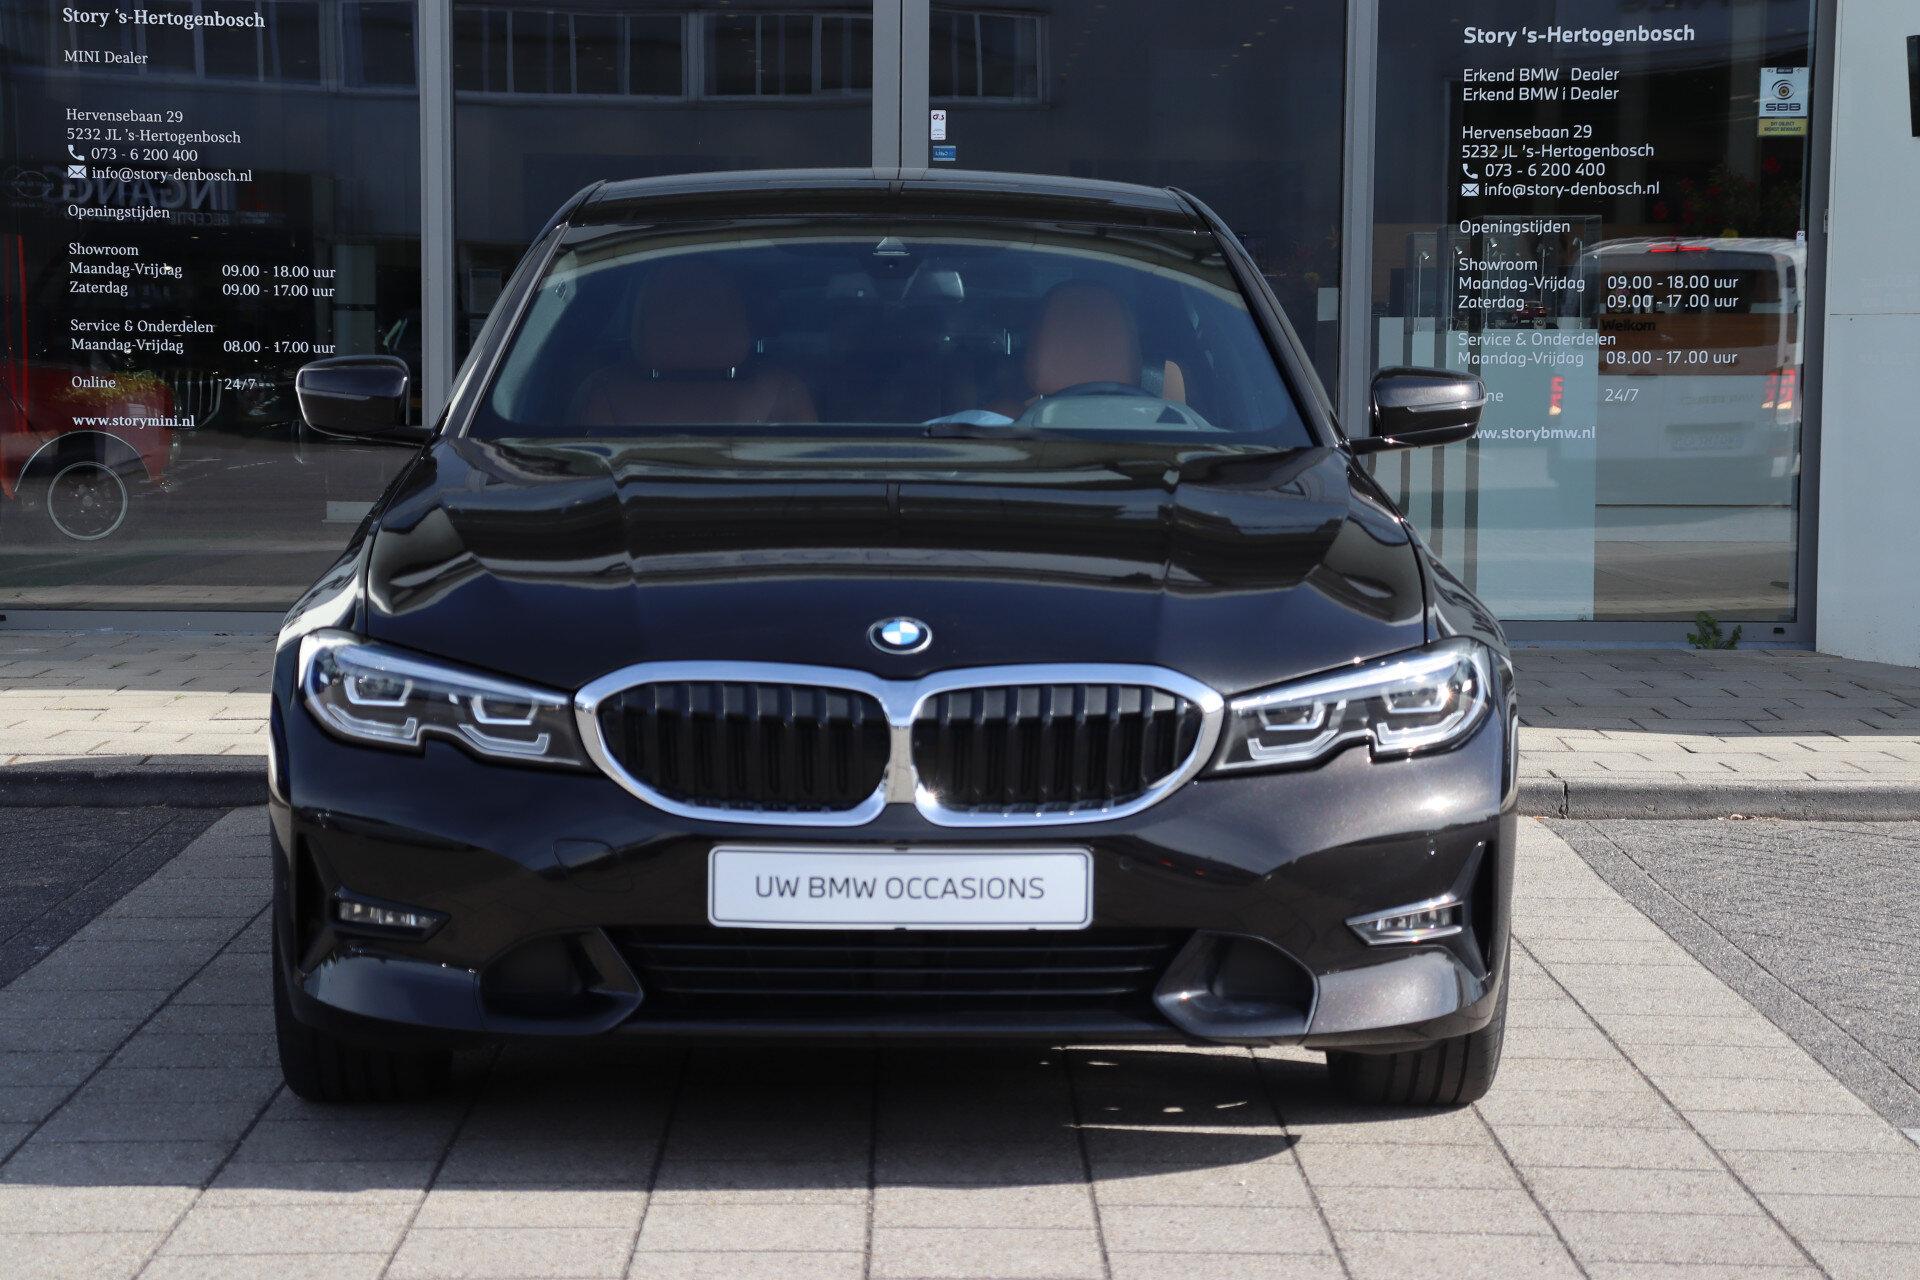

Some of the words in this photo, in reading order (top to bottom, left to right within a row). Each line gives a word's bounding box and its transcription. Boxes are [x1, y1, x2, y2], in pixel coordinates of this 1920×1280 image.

[62, 7, 109, 27] Story
[1463, 27, 1517, 47] Story
[64, 50, 100, 63] MINI
[104, 51, 149, 65] Dealer
[1463, 68, 1515, 82] Erkend
[1519, 68, 1559, 82] BMW
[1571, 67, 1620, 81] Dealer
[1463, 88, 1515, 101] Erkend
[1518, 87, 1559, 101] BMW
[1562, 86, 1566, 101] i
[1570, 86, 1620, 101] Dealer
[66, 108, 162, 123] Hervensebaan
[166, 111, 184, 123] 29
[66, 127, 101, 141] 5232
[104, 128, 122, 141] JL
[1462, 126, 1569, 140] Hervensebaan
[1573, 124, 1593, 139] 29
[91, 148, 117, 160] 073
[129, 149, 139, 161] 6
[142, 149, 169, 161] 200
[172, 150, 198, 162] 400
[1461, 145, 1498, 158] 5232
[1501, 145, 1518, 159] JL
[91, 166, 253, 184] info@story-denbosch.nl
[1485, 163, 1512, 177] 073
[1527, 164, 1537, 177] 6
[1540, 163, 1571, 177] 200
[1574, 162, 1606, 177] 400
[1484, 181, 1660, 199] info@story-denbosch.nl
[67, 204, 171, 222] Openingstijden
[1459, 219, 1571, 237] Openingstijden
[68, 242, 139, 256] Showroom
[69, 262, 183, 279] Maandag-Vrijdag
[222, 264, 260, 277] 09.00
[273, 265, 310, 278] 18.00
[312, 269, 336, 278] uur
[1459, 257, 1538, 271] Showroom
[69, 280, 129, 297] Zaterdag
[1459, 276, 1585, 294] Maandag-Vrijdag
[1607, 275, 1653, 289] 09.00
[1667, 275, 1710, 288] 18.00
[1714, 279, 1739, 288] uur
[222, 283, 260, 296] 09.00
[273, 285, 309, 297] 17.00
[312, 288, 335, 297] uur
[1458, 295, 1525, 312] Zaterdag
[1607, 294, 1652, 308] 09.00
[1714, 297, 1739, 308] uur
[70, 318, 121, 332] Service
[124, 320, 134, 332] &
[137, 320, 214, 333] Onderdelen
[1601, 319, 1656, 332] Welkom
[70, 338, 184, 355] Maandag-Vrijdag
[1458, 332, 1511, 346] Service
[1515, 332, 1527, 346] &
[1531, 332, 1616, 346] Onderdelen
[223, 340, 261, 353] 08.00
[273, 342, 309, 354] 17.00
[312, 345, 336, 354] uur
[1458, 351, 1584, 367] Maandag-Vrijdag
[1606, 351, 1652, 364] 08.00
[1713, 354, 1738, 364] uur
[71, 375, 117, 389] Online
[224, 378, 256, 391] 24/7
[1604, 388, 1639, 402] 24/7
[72, 414, 195, 430] www.storymini.nl
[1471, 426, 1596, 442] ww.storybmw.nl
[755, 875, 800, 899] UW
[808, 876, 877, 899] BMW
[885, 876, 1045, 900] OCCASIONS
